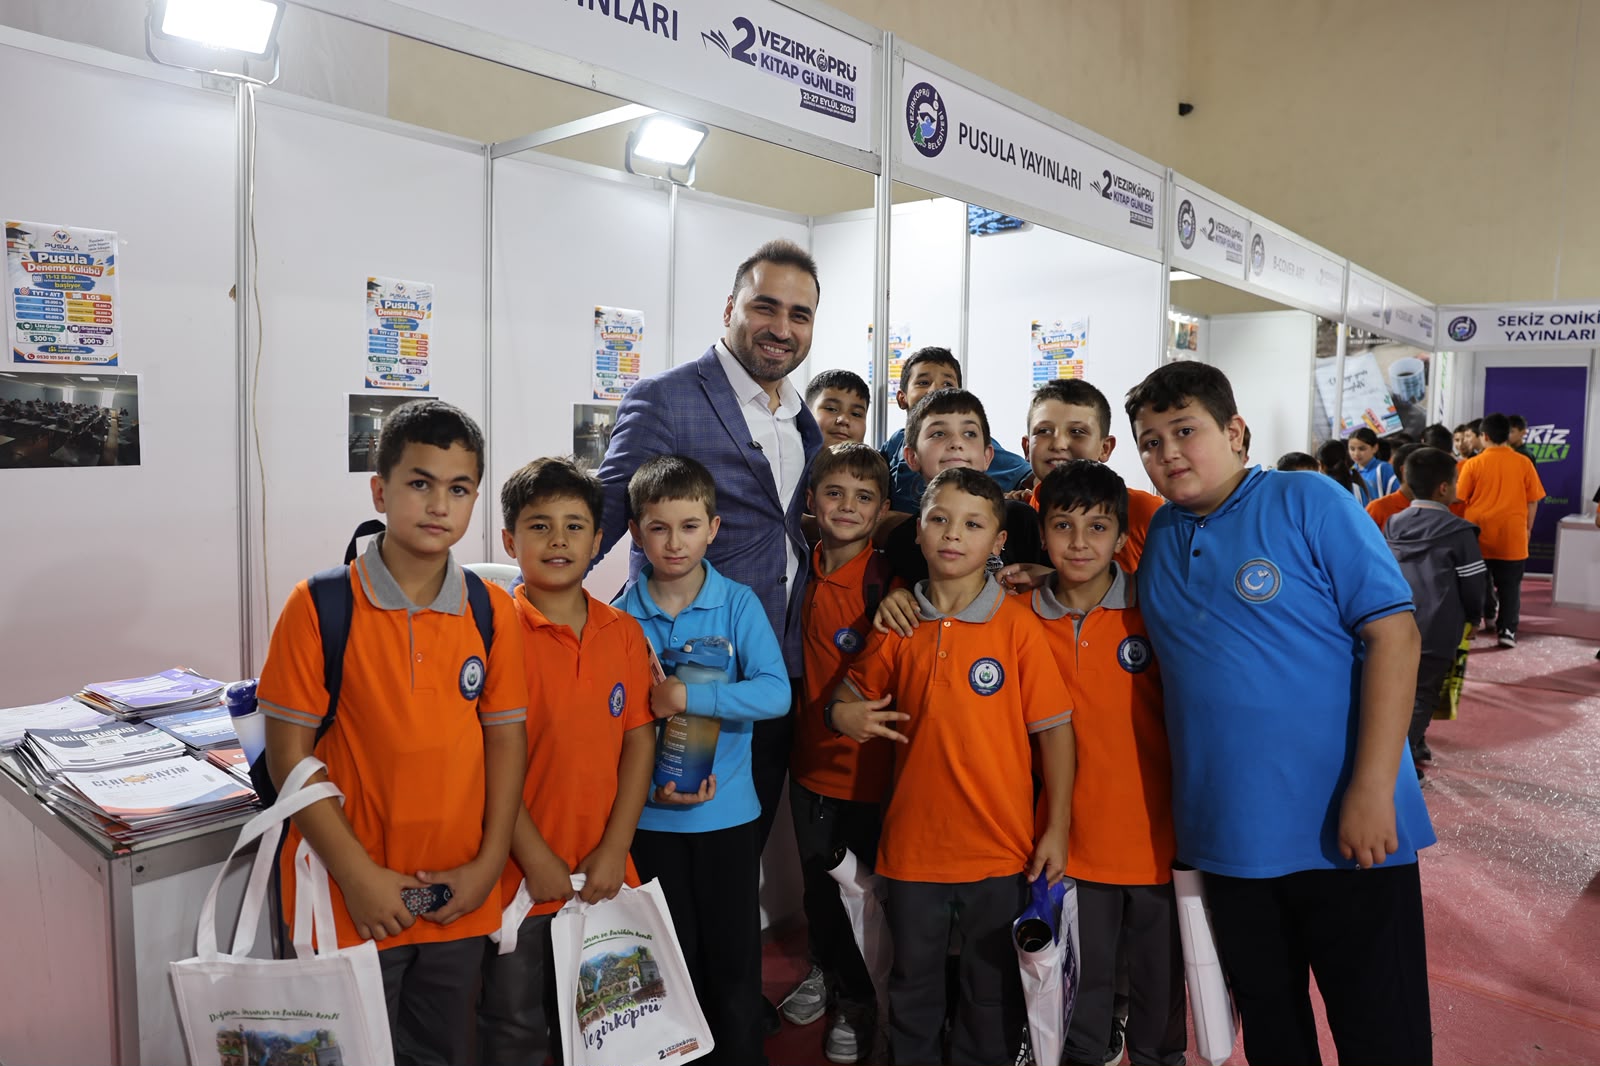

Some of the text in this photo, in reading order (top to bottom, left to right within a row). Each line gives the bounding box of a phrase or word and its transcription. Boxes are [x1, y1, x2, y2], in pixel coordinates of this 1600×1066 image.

[760, 52, 854, 102] KİTAP GÜNLERİ
[820, 97, 839, 110] EYLÜL
[958, 121, 1082, 191] PUSULA YAYINLARI
[44, 242, 79, 251] PUSULA
[37, 252, 87, 265] Pusula
[27, 262, 101, 275] Deneme Kulübü
[384, 300, 416, 310] Pusula
[1498, 310, 1600, 327] SEKİZ ONİKİ
[1505, 329, 1596, 342] YAYINLARI
[582, 998, 662, 1050] Vezirköprü
